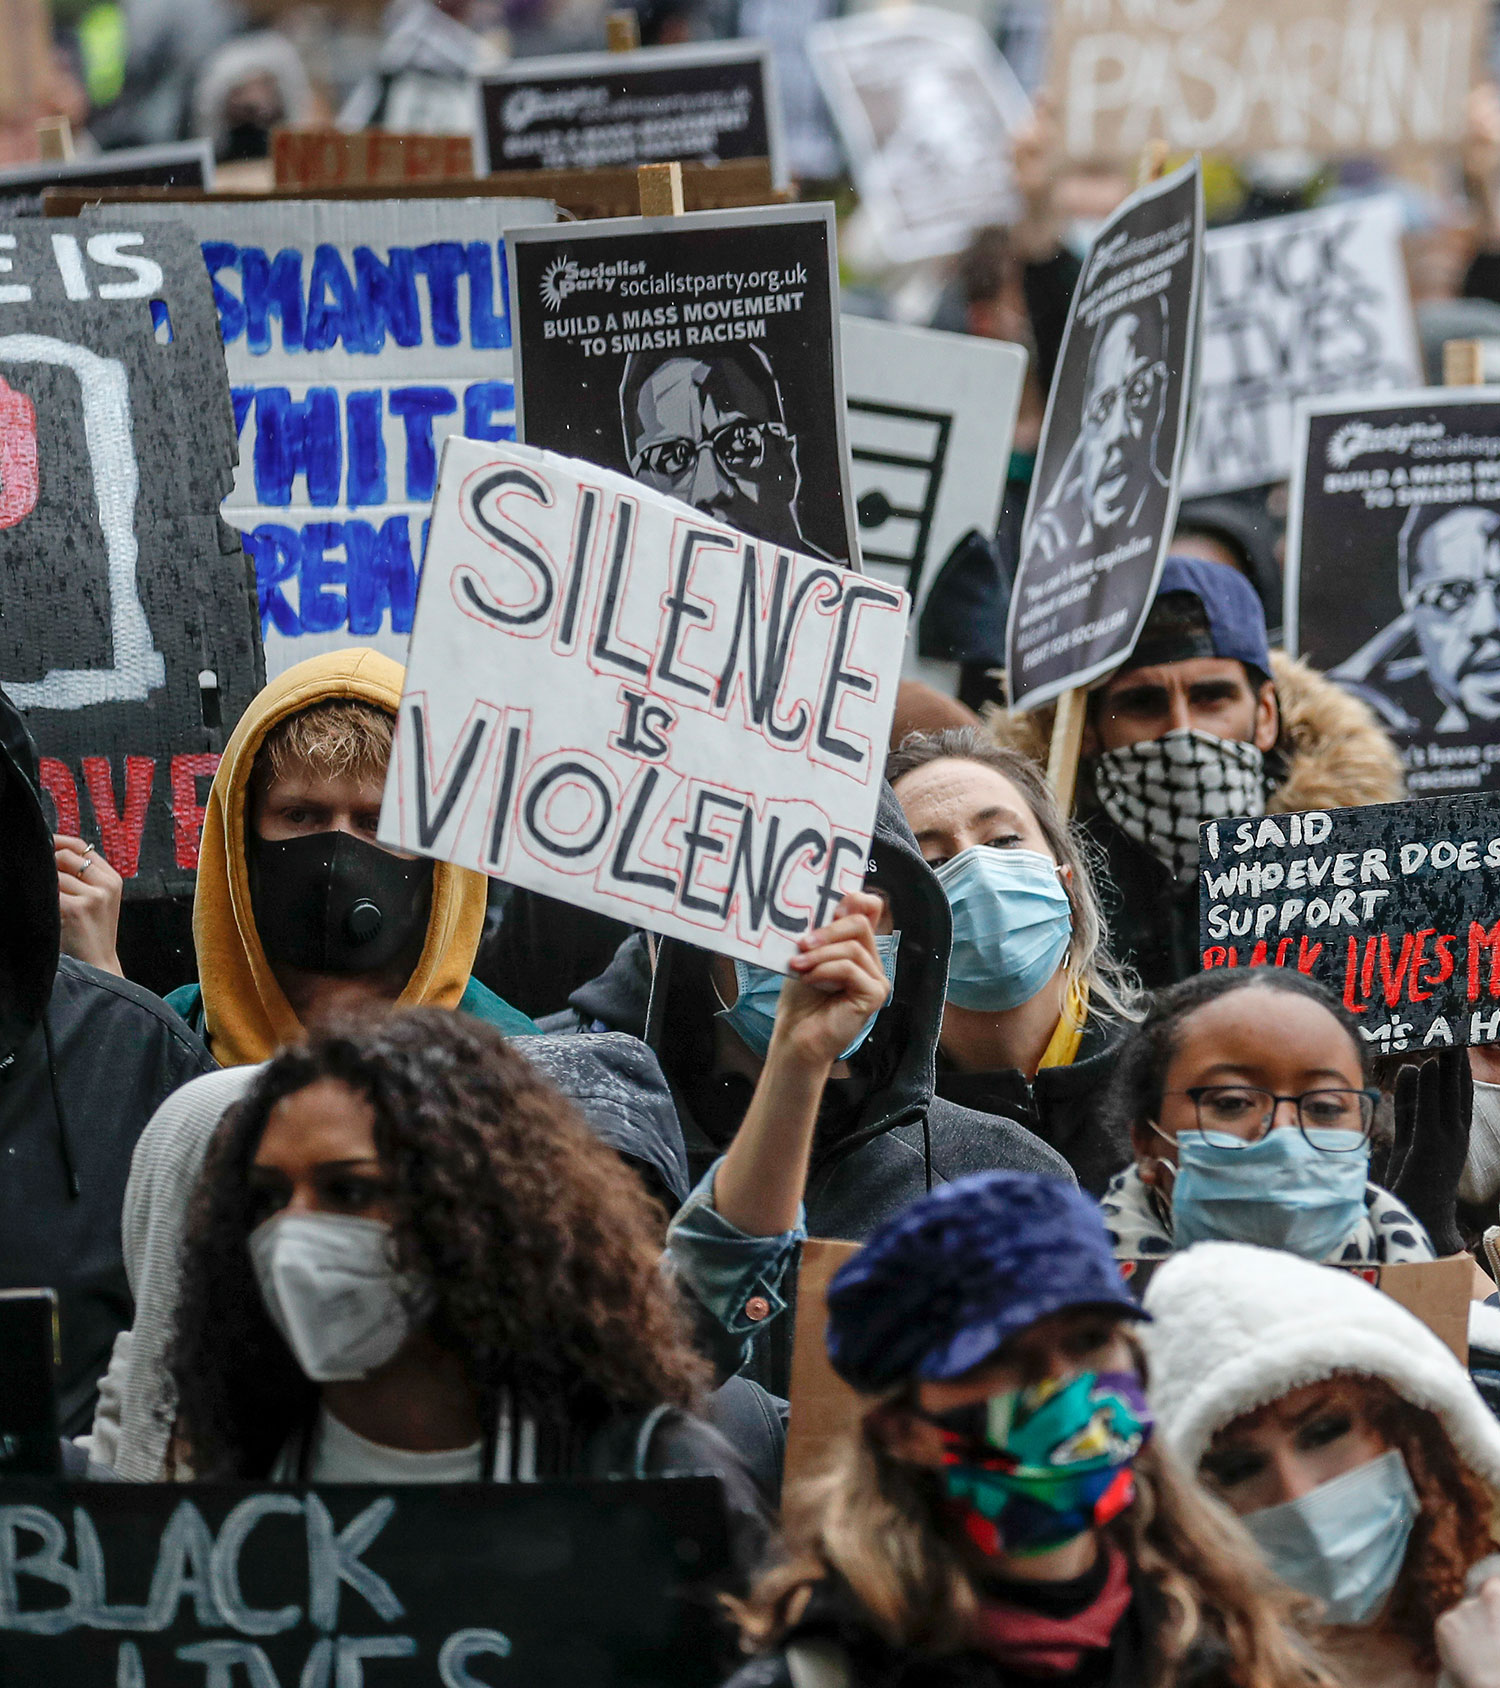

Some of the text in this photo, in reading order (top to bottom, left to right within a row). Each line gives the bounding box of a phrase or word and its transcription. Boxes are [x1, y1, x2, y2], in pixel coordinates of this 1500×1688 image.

[51, 232, 164, 301] IS
[559, 276, 615, 298] party
[564, 260, 647, 280] Socialist
[620, 262, 807, 297] socialistparty.org.uk
[543, 291, 804, 340] BUILD A MASS MOVEMENT
[580, 319, 767, 358] TO SMASH RACISM
[1323, 469, 1389, 494] BUILD
[1390, 466, 1409, 487] A
[1409, 461, 1473, 485] MASS
[1361, 487, 1394, 509] TO
[1395, 482, 1473, 507] SMASH
[454, 464, 902, 780] SILENCE
[612, 687, 675, 760] IS
[1427, 743, 1481, 765] have
[404, 697, 868, 940] VIOLENCE
[1206, 811, 1333, 860] I SAID
[1203, 849, 1390, 900] WHOEVER
[1207, 889, 1389, 940] SUPPORT
[1342, 928, 1458, 1014] LIVES
[1422, 1015, 1454, 1048] A
[0, 1493, 405, 1636] BLACK
